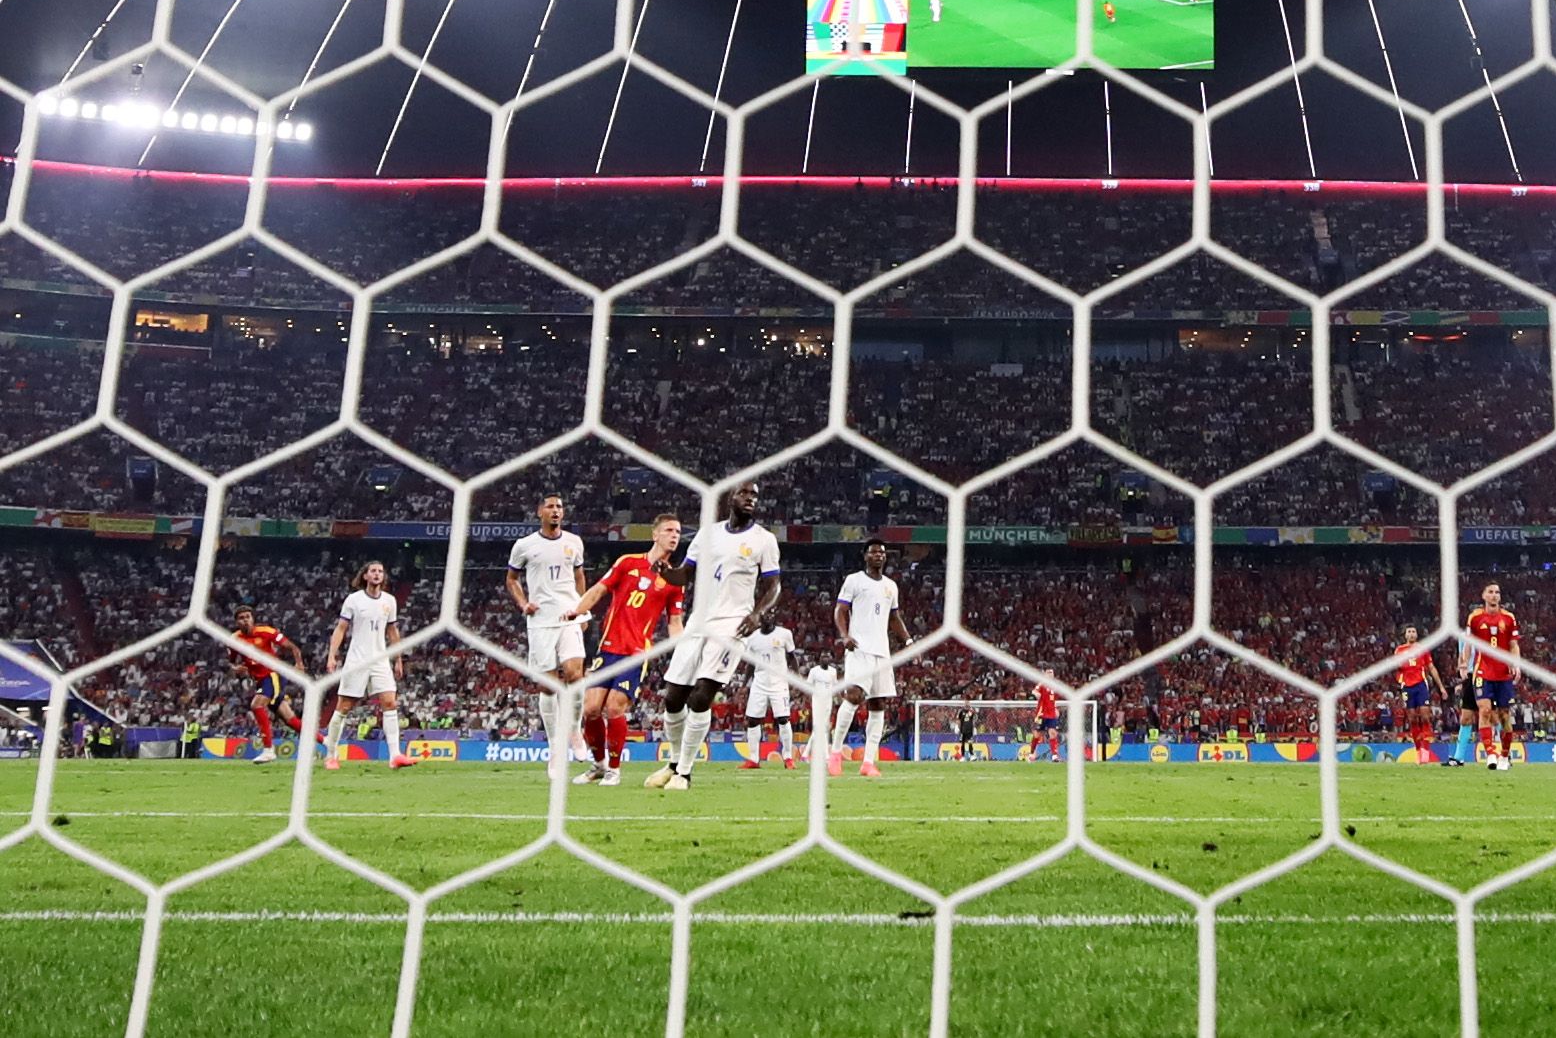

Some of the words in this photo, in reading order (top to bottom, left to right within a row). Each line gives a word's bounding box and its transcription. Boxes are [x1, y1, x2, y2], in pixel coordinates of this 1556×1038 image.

[549, 565, 561, 580] 17
[713, 563, 722, 583] 4
[626, 591, 646, 609] 10
[874, 602, 881, 616] 8
[1490, 636, 1498, 649] 8
